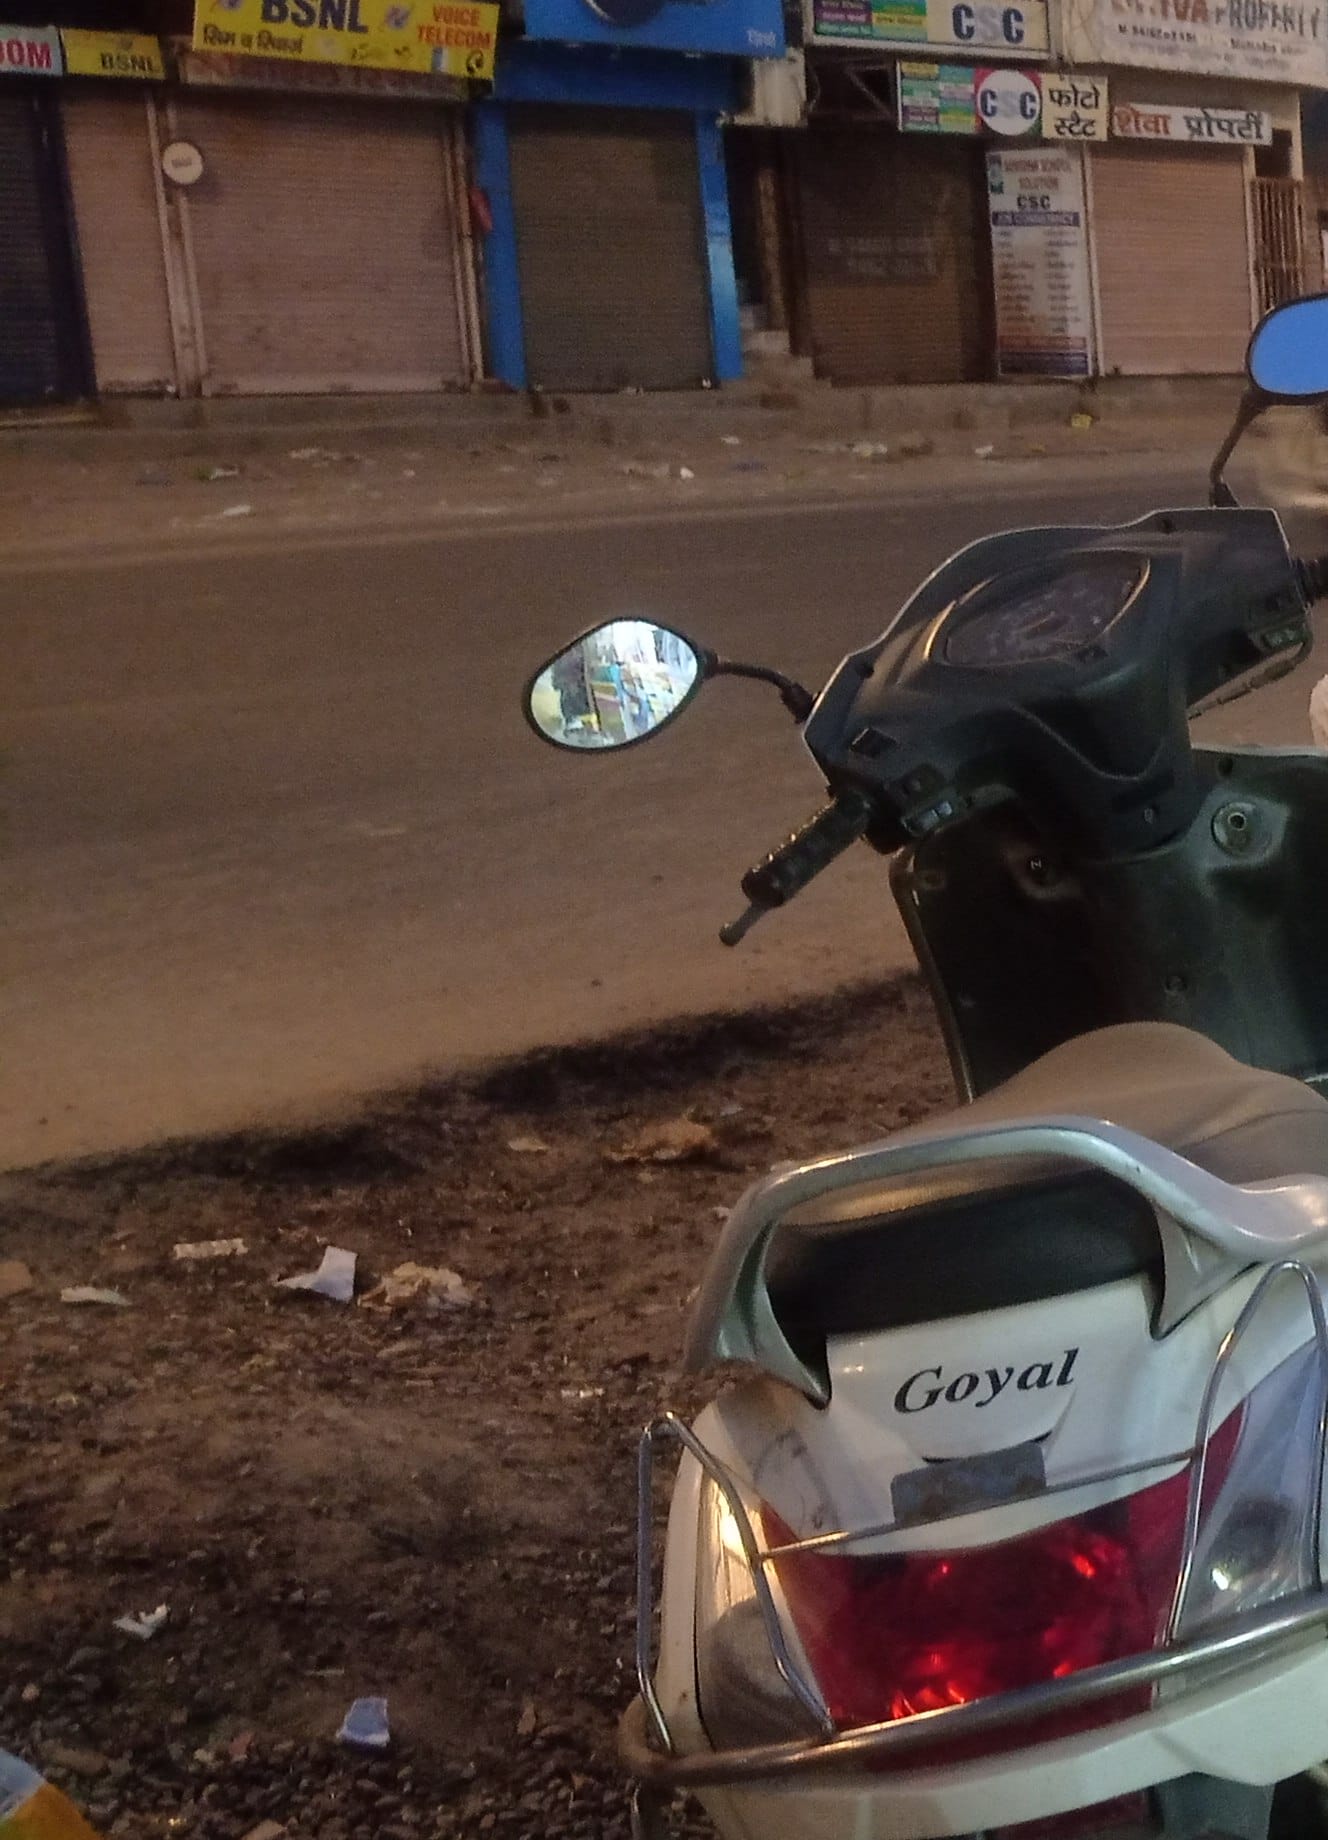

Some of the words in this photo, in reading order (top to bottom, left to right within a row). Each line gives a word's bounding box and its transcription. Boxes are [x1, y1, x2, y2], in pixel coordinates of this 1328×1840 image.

[434, 6, 481, 26] VOICE
[952, 3, 1024, 44] CSC
[418, 24, 491, 47] TELECOM
[0, 39, 52, 70] OM
[1048, 82, 1100, 109] फोटो
[893, 1349, 1080, 1414] Goyal
